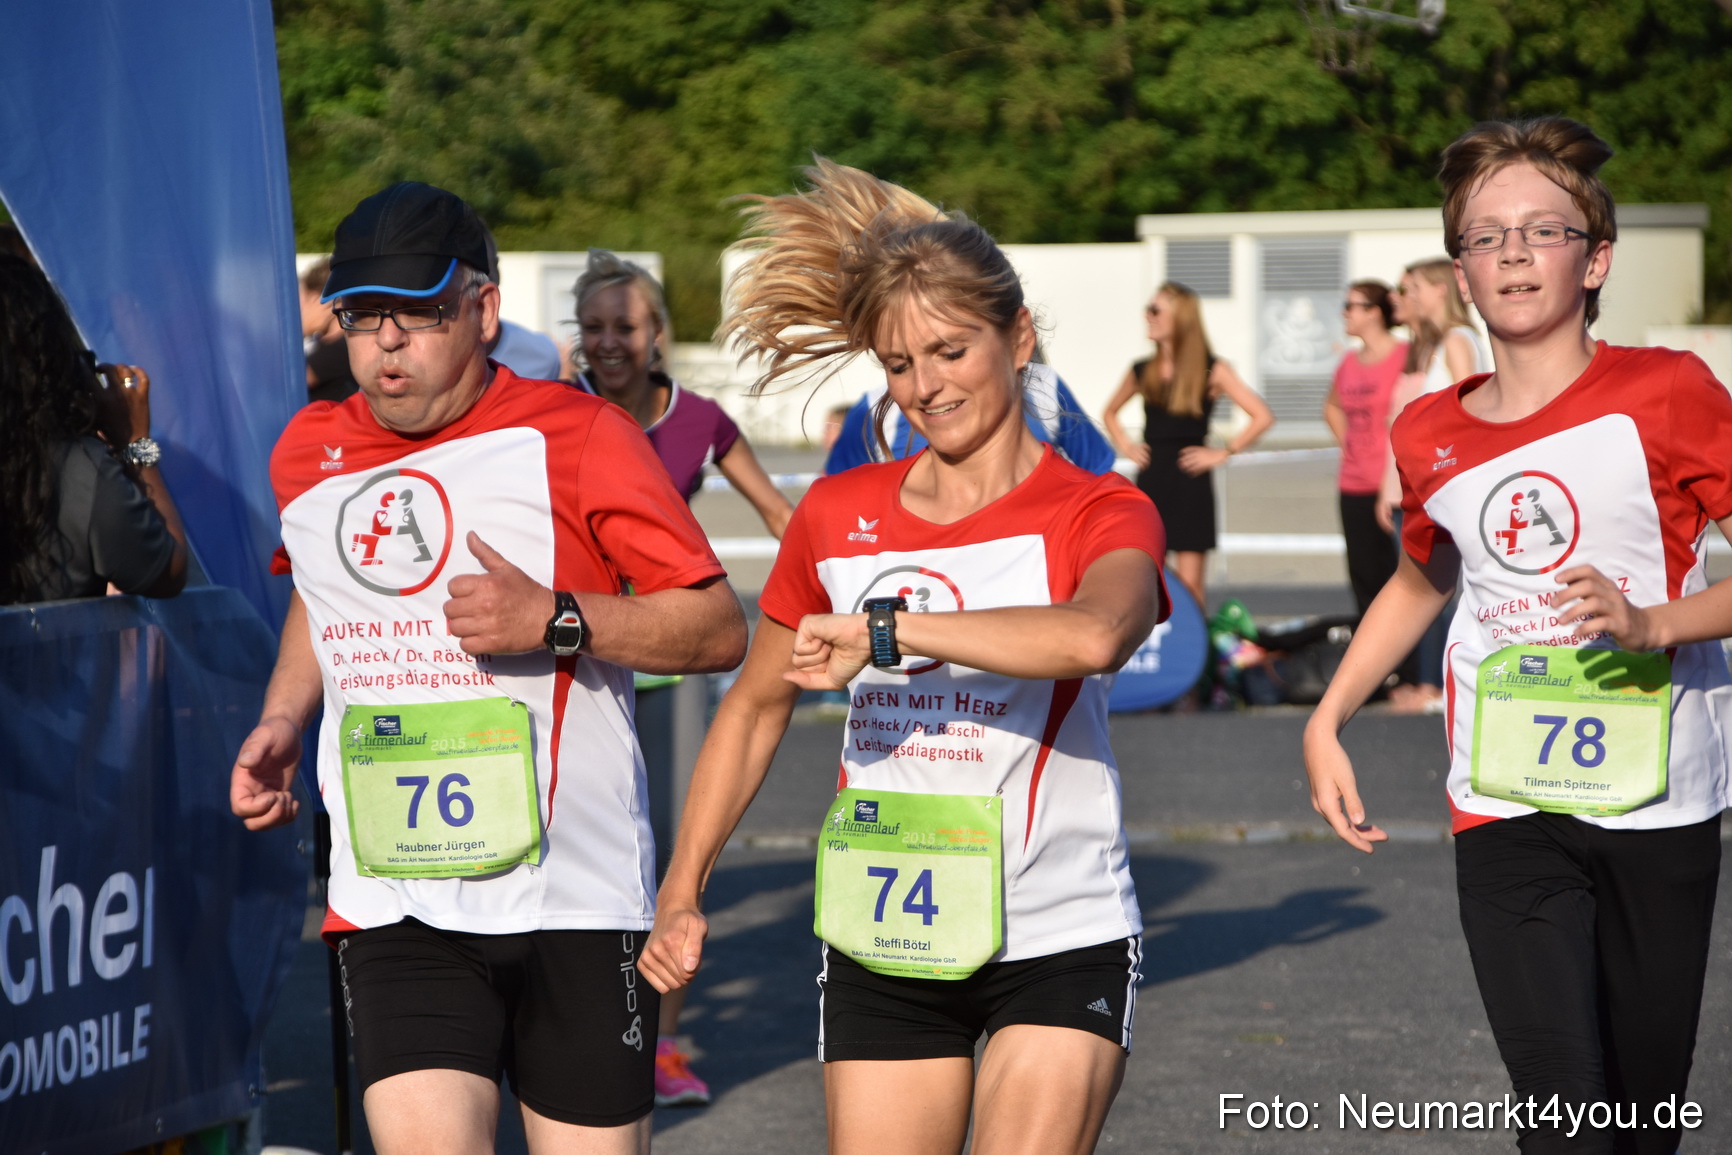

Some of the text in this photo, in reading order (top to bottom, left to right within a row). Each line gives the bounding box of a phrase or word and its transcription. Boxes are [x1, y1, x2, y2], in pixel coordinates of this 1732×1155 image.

[1432, 458, 1457, 470] erima
[847, 530, 878, 543] erima
[1477, 598, 1530, 622] LAUFEN
[322, 621, 382, 641] AUFEN
[393, 620, 433, 637] MIT
[1492, 628, 1507, 639] Dr.
[1508, 621, 1537, 634] Heck
[333, 653, 347, 666] Dr.
[352, 648, 390, 664] Heck
[406, 650, 427, 663] Dr.
[1505, 672, 1573, 687] firmenlauf
[908, 694, 945, 710] MIT
[955, 692, 1008, 716] HERZ
[850, 719, 871, 731] Dr.
[872, 717, 900, 732] Heck
[913, 721, 933, 734] Dr.
[938, 721, 985, 739] Röschl
[364, 732, 428, 746] firmenlauf
[431, 738, 467, 750] 2015
[1533, 714, 1606, 768] 78
[1524, 777, 1611, 791] Tilman Spitzner
[396, 773, 474, 828] 76
[1575, 794, 1608, 802] Kardiologie
[843, 818, 900, 835] firmenlauf
[902, 832, 935, 844] 2015
[396, 839, 486, 853] Haubner Jürgen
[867, 866, 939, 926] 74
[874, 937, 931, 951] Steffi Bötzl
[881, 953, 907, 961] Neumarkt
[910, 955, 942, 964] Kardiologie
[1086, 1004, 1112, 1017] adidas
